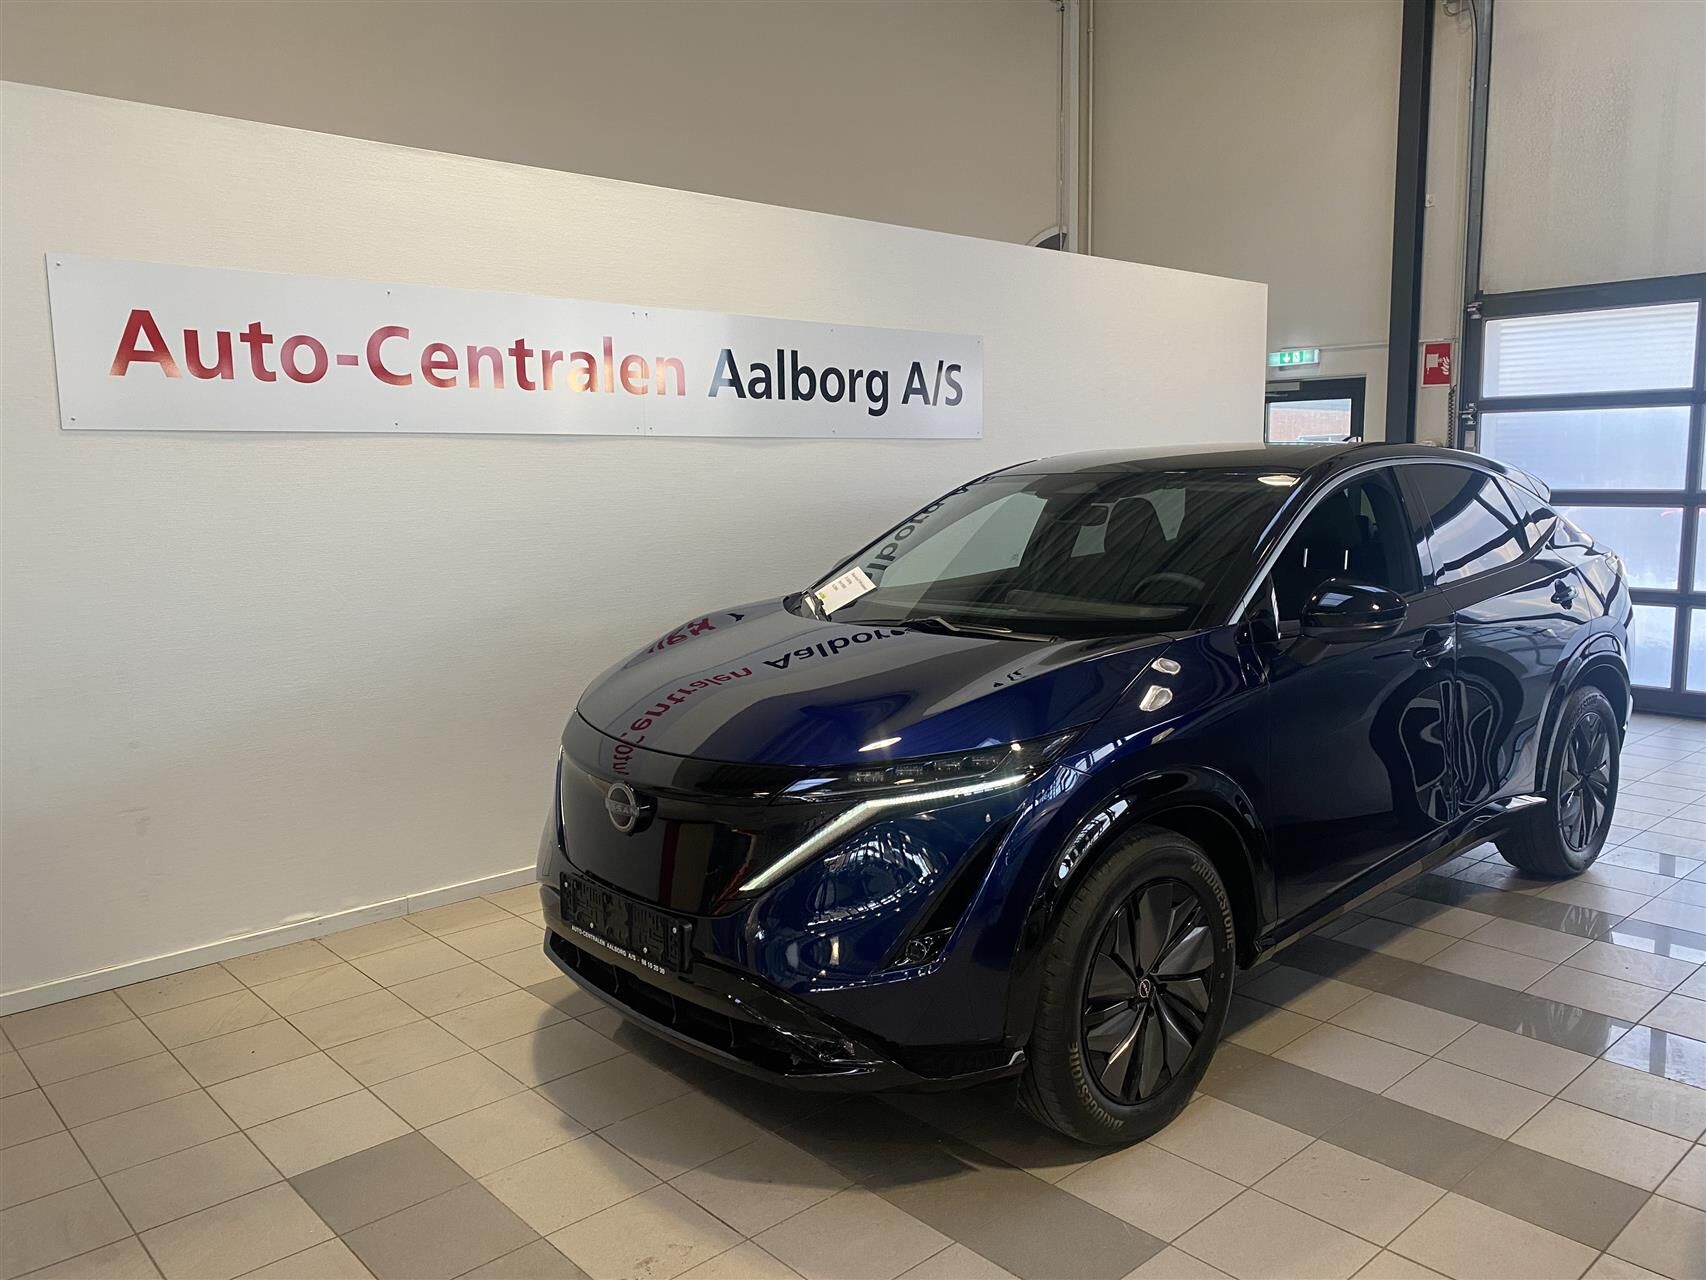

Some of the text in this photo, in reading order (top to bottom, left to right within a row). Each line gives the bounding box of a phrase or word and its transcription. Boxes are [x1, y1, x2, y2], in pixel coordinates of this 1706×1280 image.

[109, 308, 964, 417] Auto-Centralen Aalborg A/S
[571, 924, 606, 947] AUTO-CENTRALEN
[606, 942, 627, 957] AALBORG
[1192, 859, 1233, 950] BRIDGESTONE
